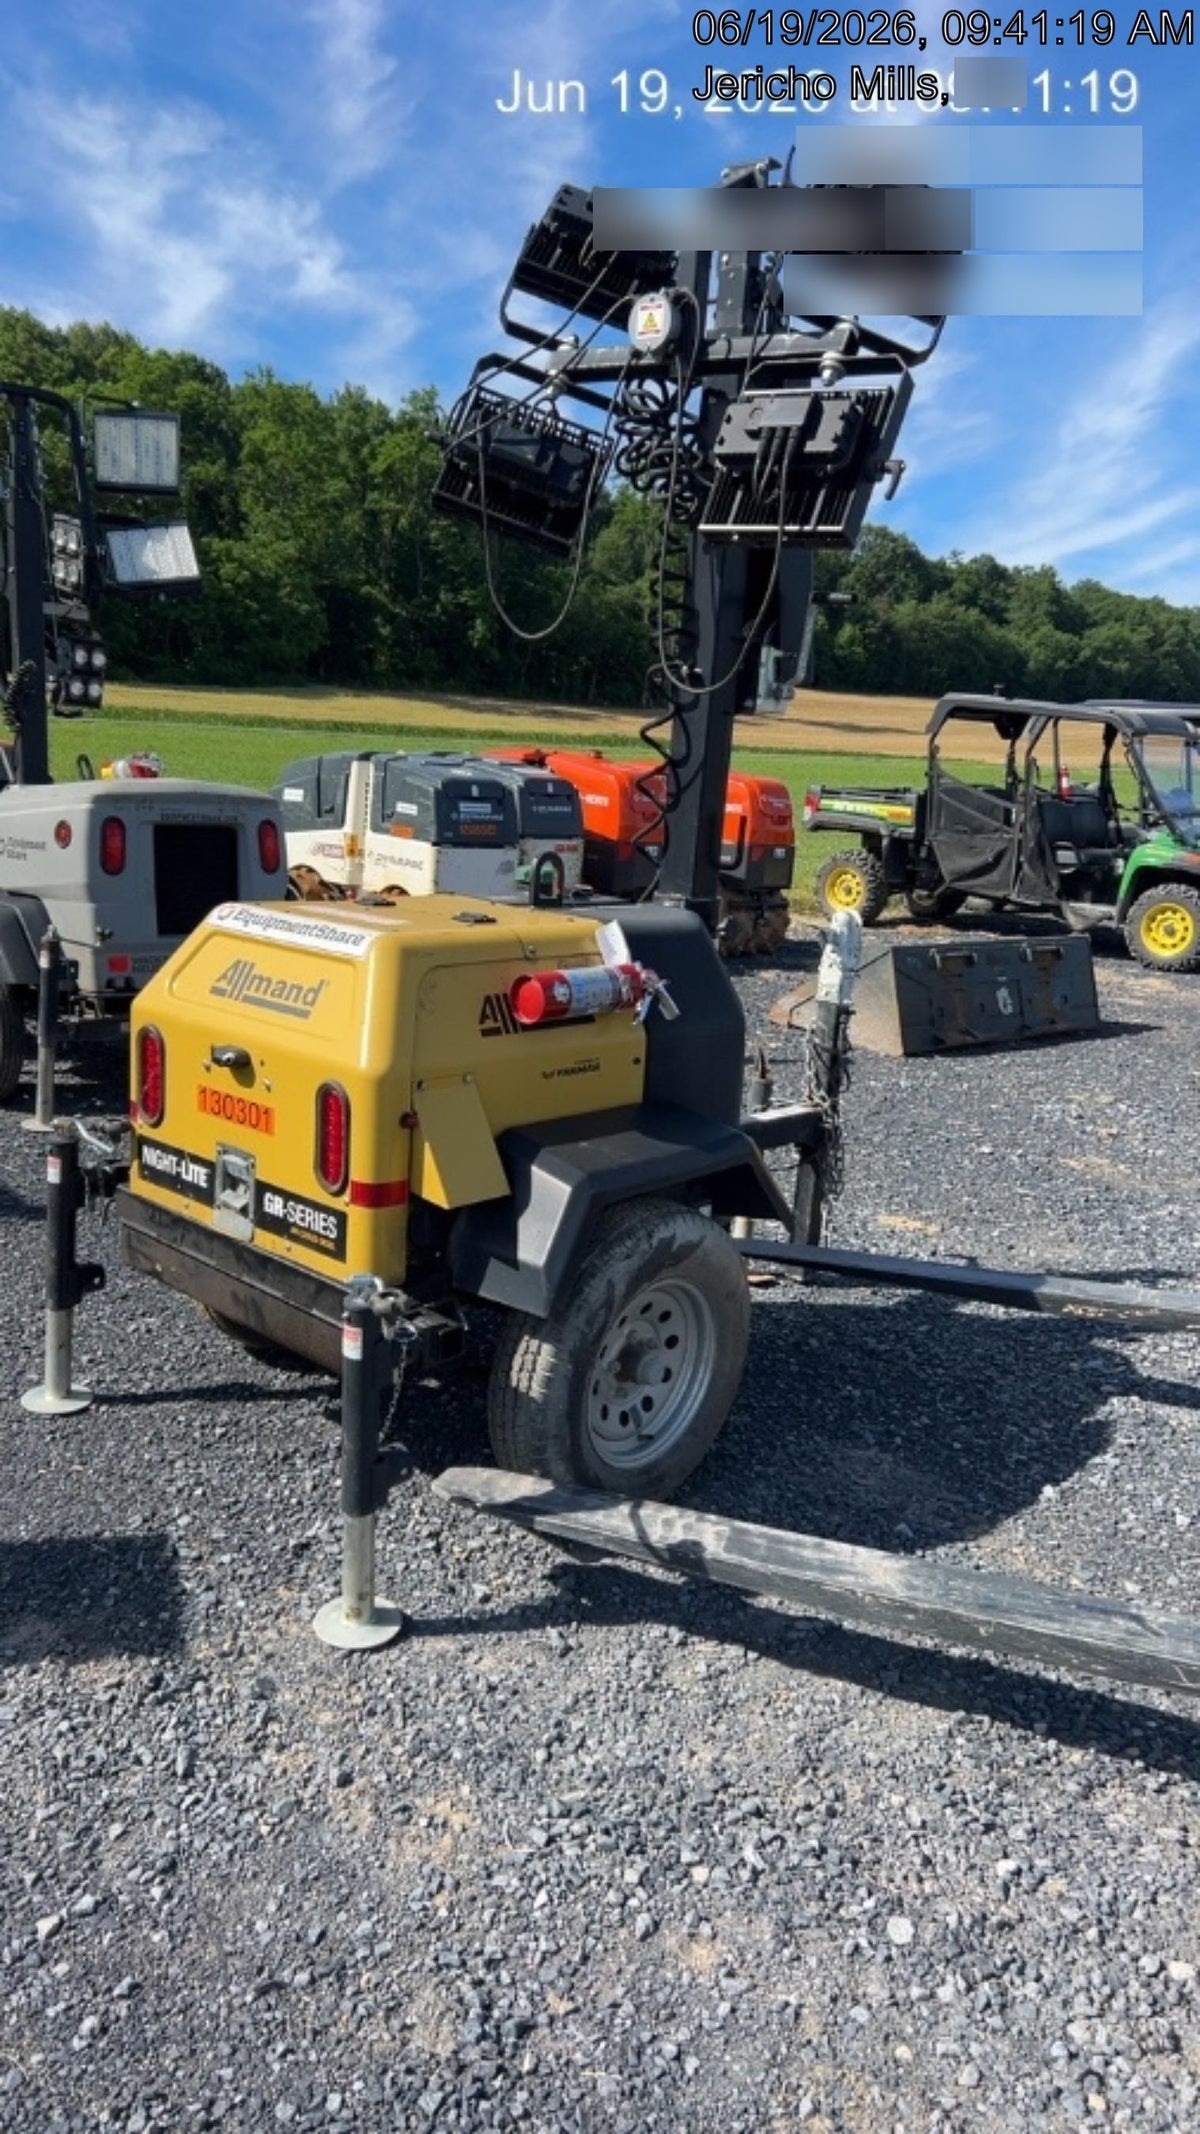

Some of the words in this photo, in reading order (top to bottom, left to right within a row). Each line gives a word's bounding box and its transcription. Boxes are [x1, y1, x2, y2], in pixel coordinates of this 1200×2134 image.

[233, 908, 366, 946] EquipmentShare
[214, 959, 326, 1008] Allmand
[199, 1086, 271, 1133] 130301
[140, 1144, 211, 1188] NIGHT-LITE
[262, 1191, 339, 1239] GR-SERIES
